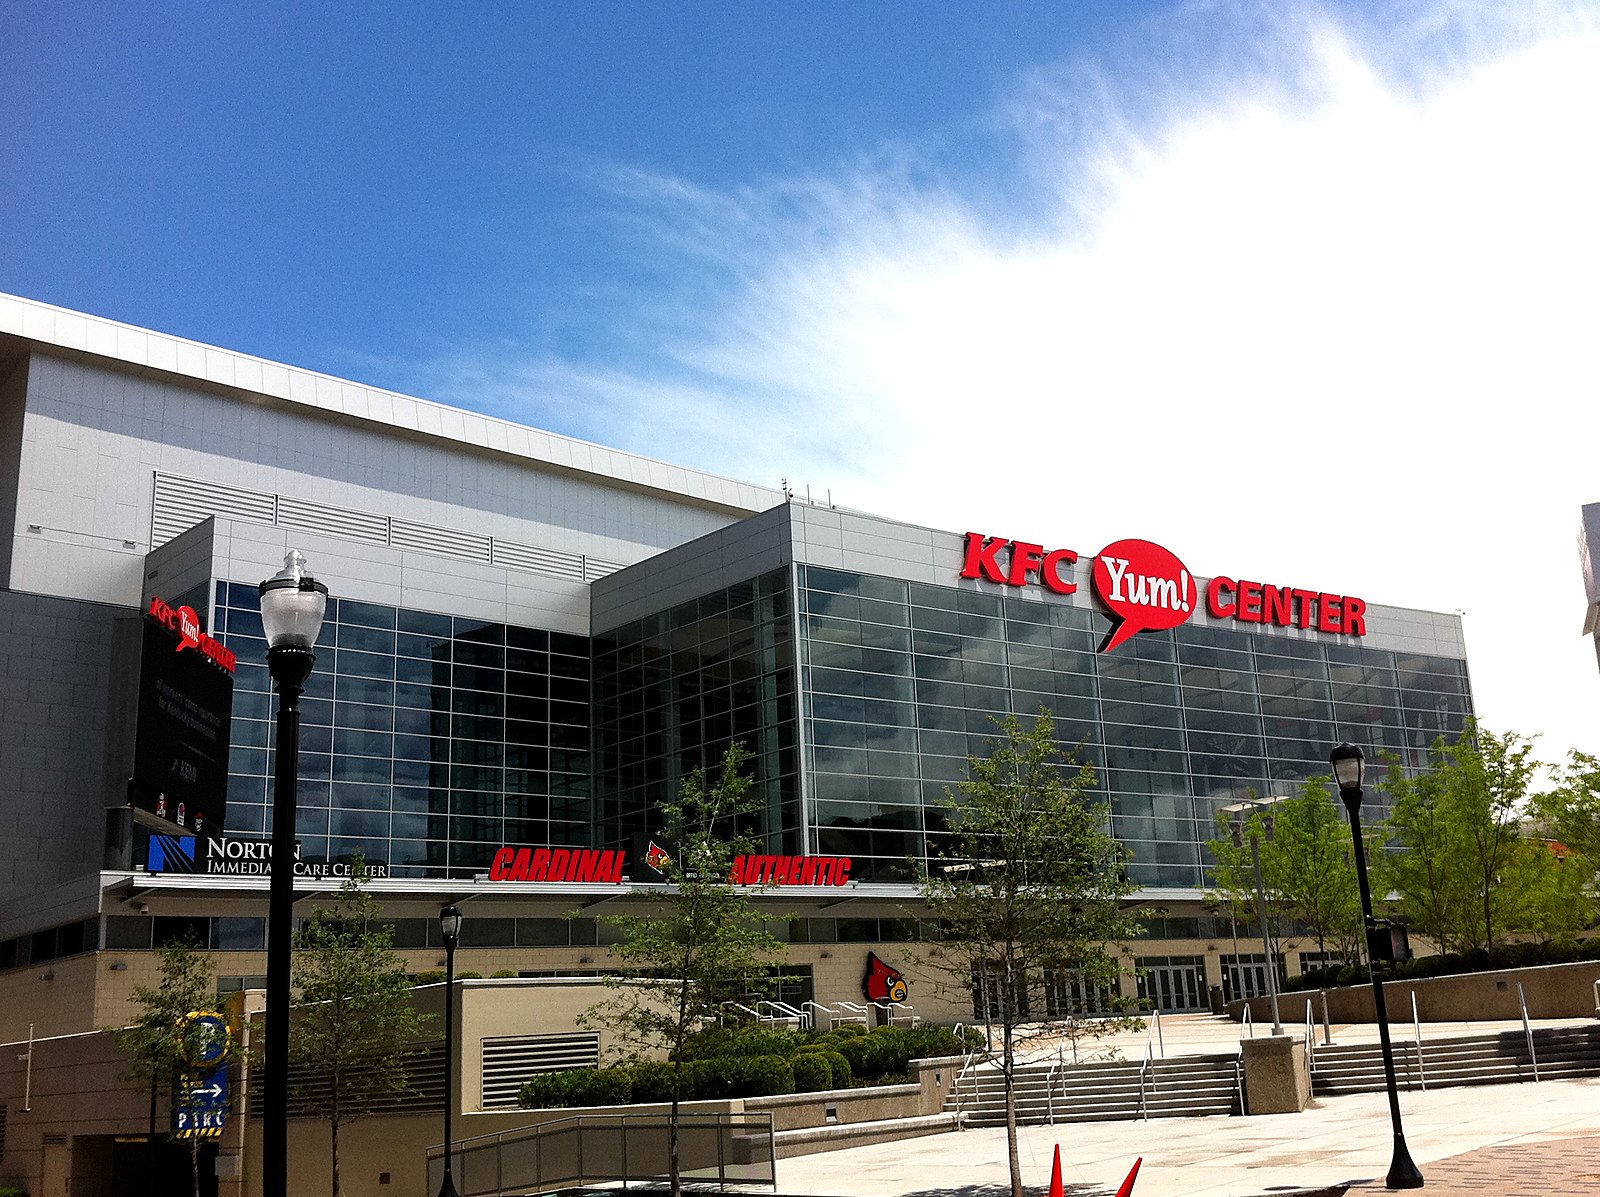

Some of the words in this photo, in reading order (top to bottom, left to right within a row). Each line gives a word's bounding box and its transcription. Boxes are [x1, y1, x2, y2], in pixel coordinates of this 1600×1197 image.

[959, 532, 1078, 594] KFC
[1100, 556, 1190, 613] Yum!
[1205, 575, 1367, 636] CENTER
[149, 596, 177, 630] KFC
[181, 610, 200, 643] Yum!
[200, 632, 237, 673] CENTER
[206, 837, 302, 860] NORTN
[207, 860, 272, 875] IMMEDIA
[293, 862, 330, 876] CARE
[488, 847, 627, 883] CARDINAL
[728, 854, 852, 887] AUTHENTIC
